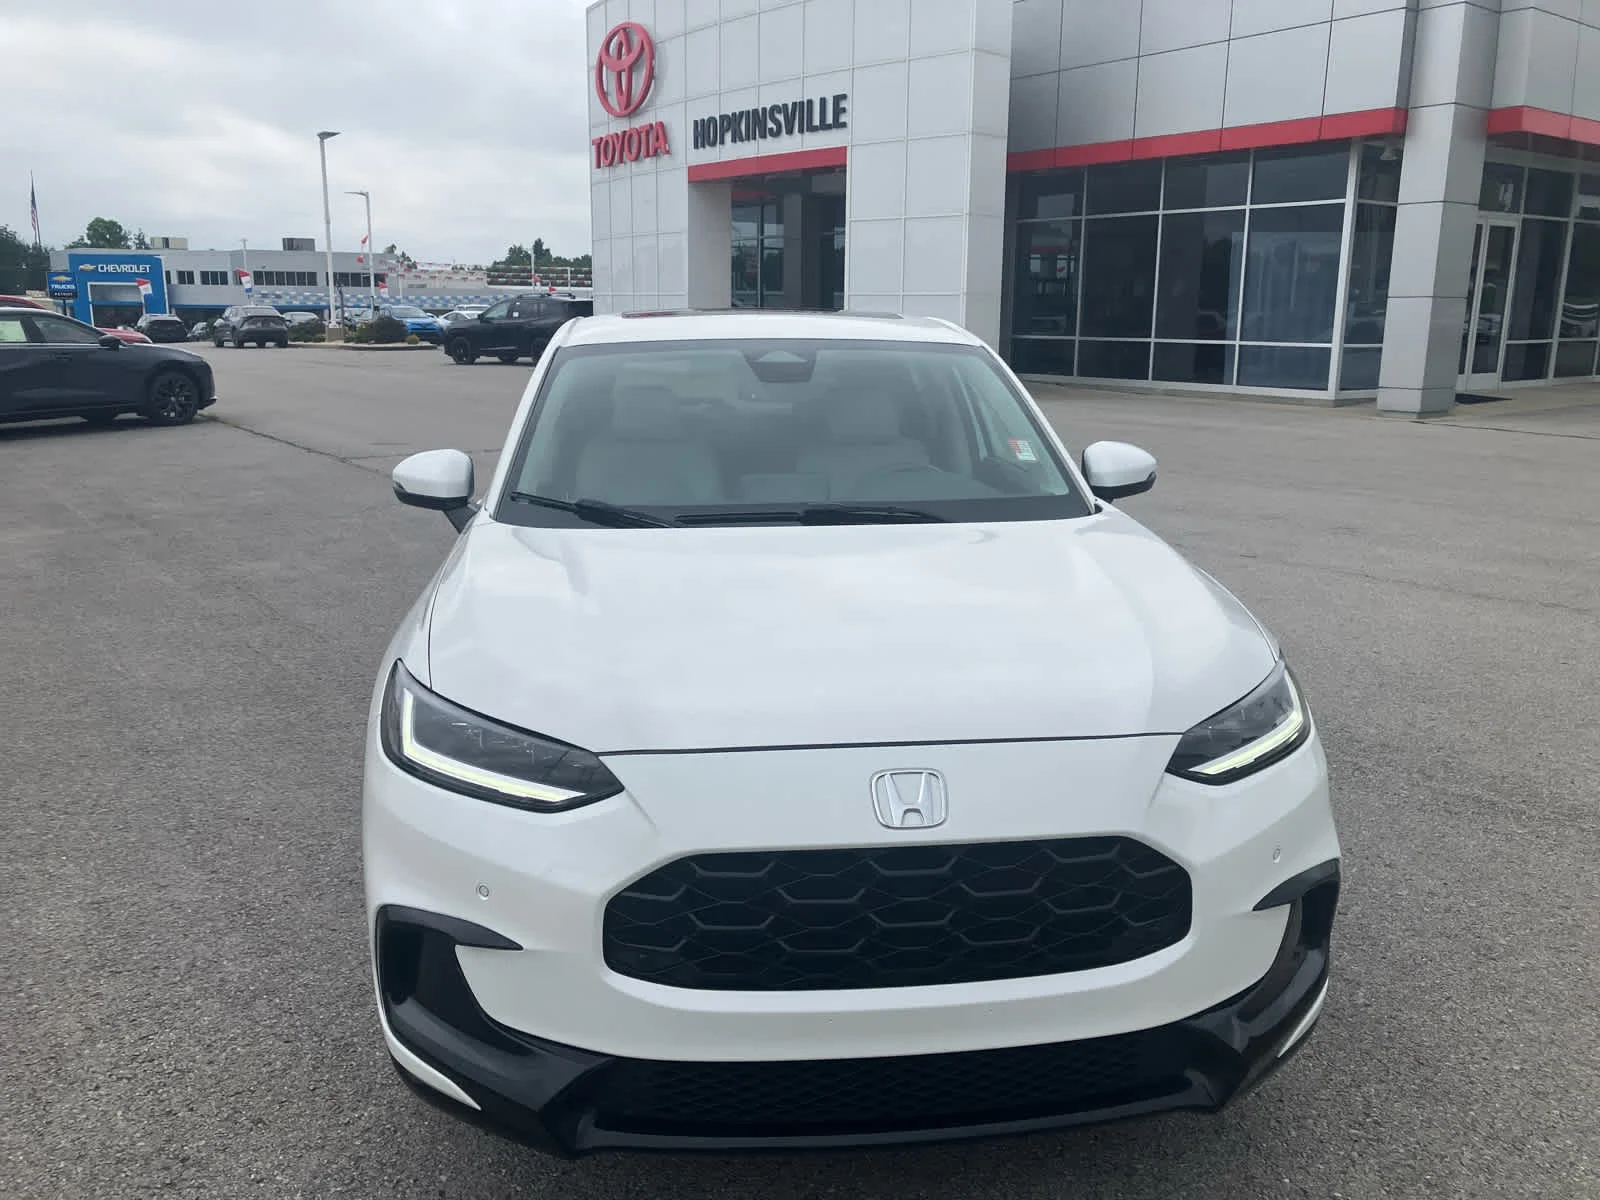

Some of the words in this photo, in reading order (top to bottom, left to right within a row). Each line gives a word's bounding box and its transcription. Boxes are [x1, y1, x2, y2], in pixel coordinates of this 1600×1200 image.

[592, 121, 670, 168] TOYOTA
[693, 93, 848, 149] HOPKINSVILLE
[97, 264, 151, 273] CHEVROLET
